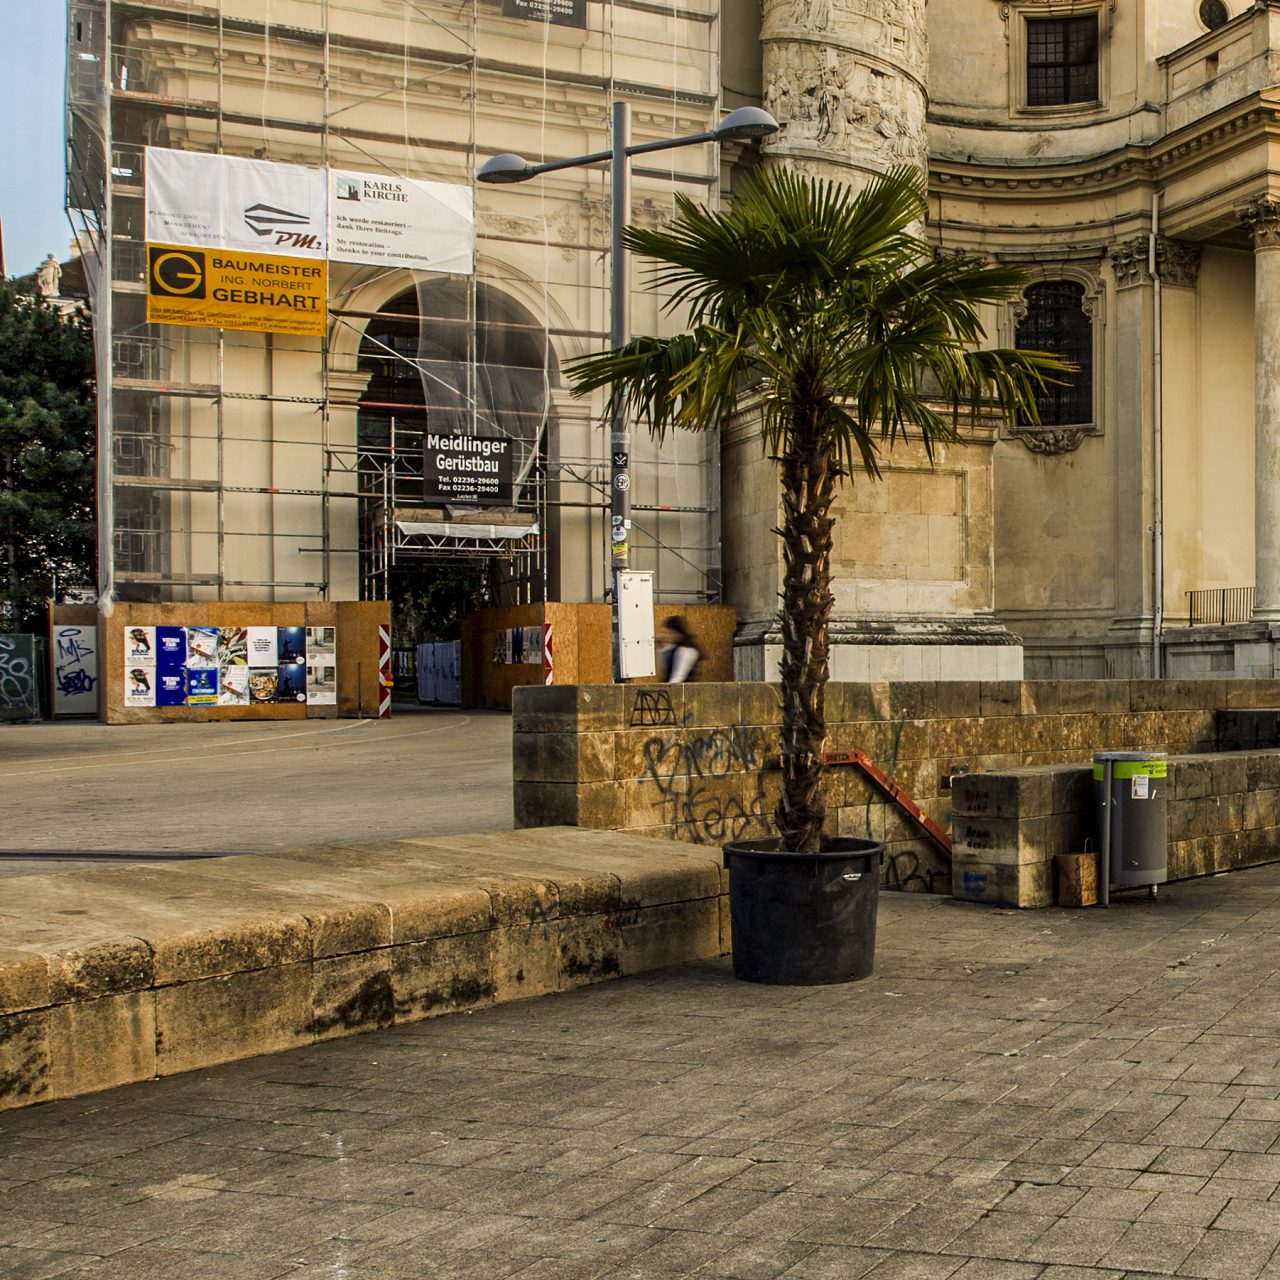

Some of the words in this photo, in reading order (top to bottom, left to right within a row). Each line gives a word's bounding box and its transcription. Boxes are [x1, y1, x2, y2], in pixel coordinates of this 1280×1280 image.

[364, 180, 402, 192] KARLS
[364, 190, 408, 202] KIRCHE
[336, 223, 353, 231] dank
[356, 225, 373, 233] Ihres
[371, 219, 406, 228] restauriert
[336, 238, 347, 246] My
[349, 240, 385, 249] restoration
[336, 246, 360, 254] thanks
[371, 250, 385, 258] your
[212, 258, 321, 278] BAUMEISTER
[220, 275, 244, 285] ING.
[252, 277, 313, 291] NORBERT
[212, 288, 320, 309] GEBHART
[427, 434, 507, 456] Meidlinger
[436, 454, 499, 473] Gerüstbau
[453, 476, 499, 485] 02236-29600
[452, 484, 499, 493] 02236-29400
